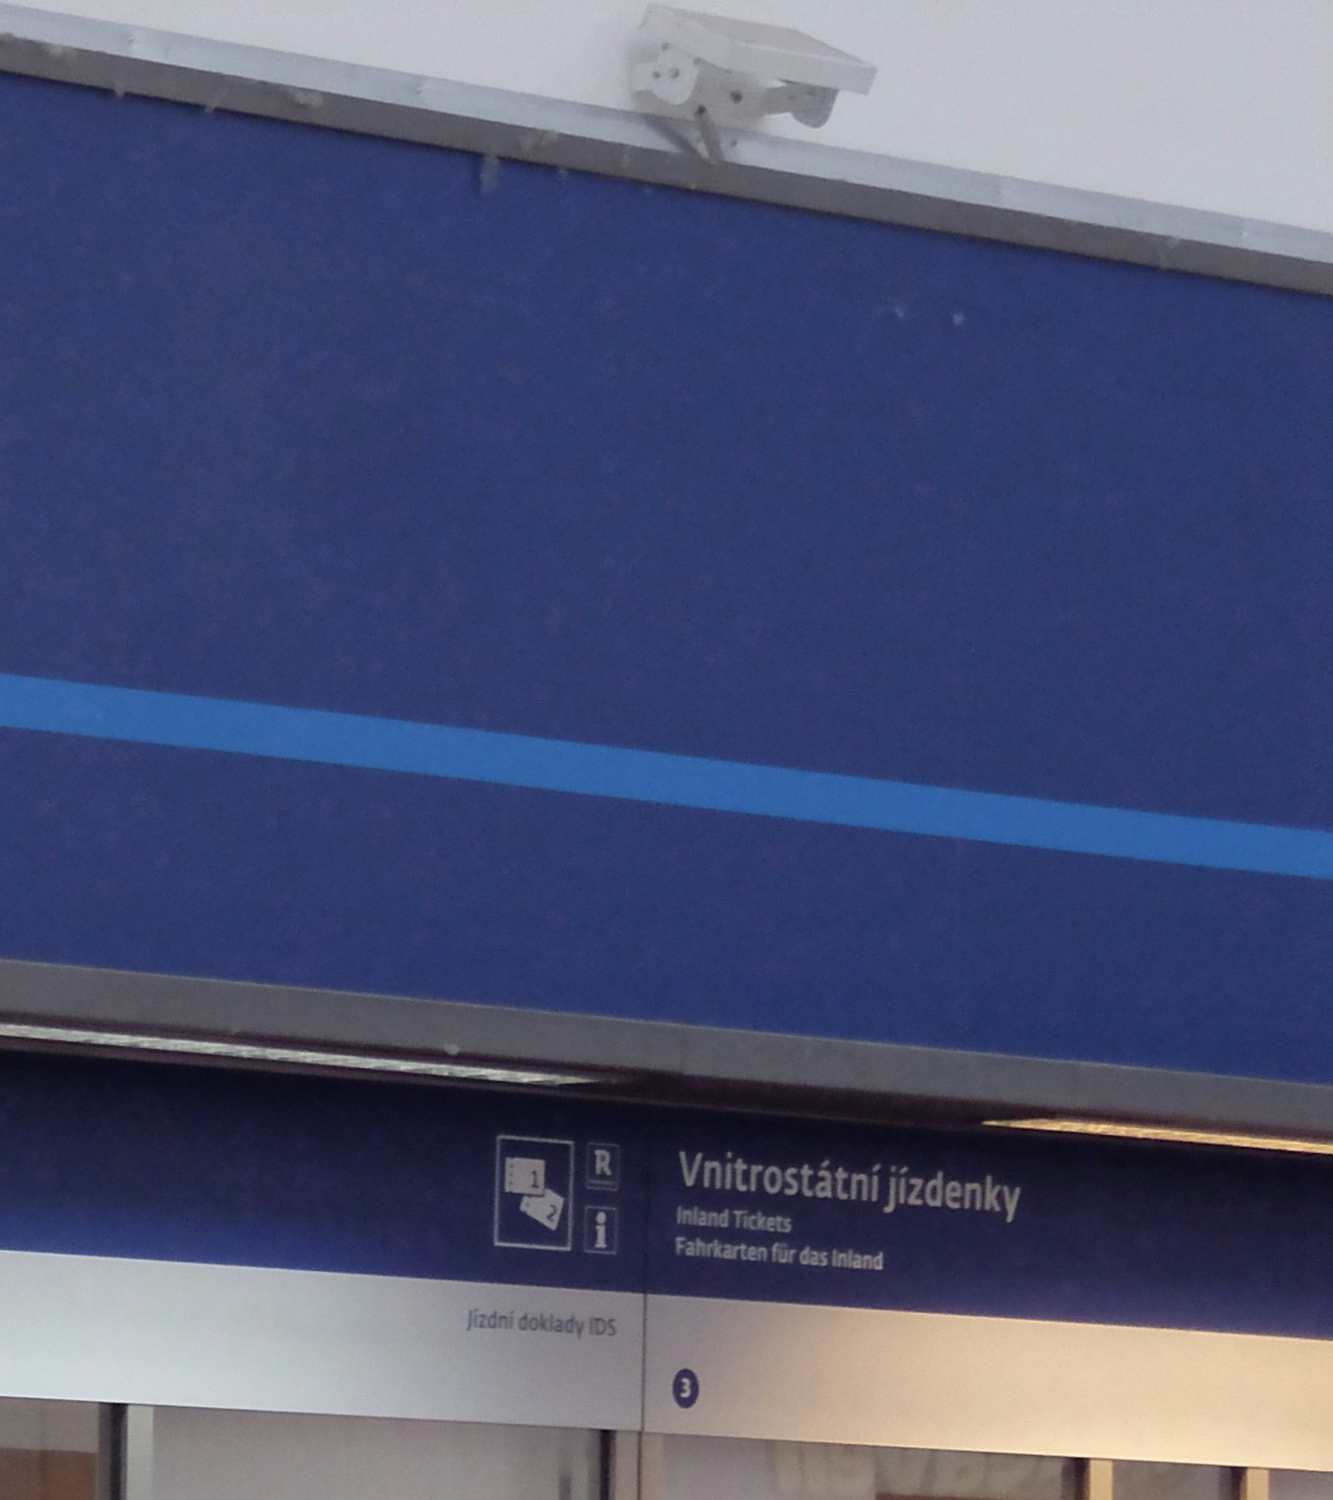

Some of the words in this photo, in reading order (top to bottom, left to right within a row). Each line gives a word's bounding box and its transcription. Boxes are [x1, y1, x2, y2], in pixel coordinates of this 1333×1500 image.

[594, 1149, 612, 1176] R
[679, 1151, 879, 1202] Vnitrostátní
[883, 1166, 1021, 1223] jízdenky
[676, 1205, 730, 1228] Inland
[732, 1209, 792, 1234] Tickets
[674, 1236, 769, 1262] Fahrkarten
[771, 1242, 797, 1264] für
[798, 1246, 829, 1267] das
[831, 1249, 884, 1271] Inland
[466, 1308, 516, 1332] Jízdní
[518, 1312, 586, 1339] doklady
[588, 1317, 617, 1337] IDS
[680, 1377, 692, 1398] 3
